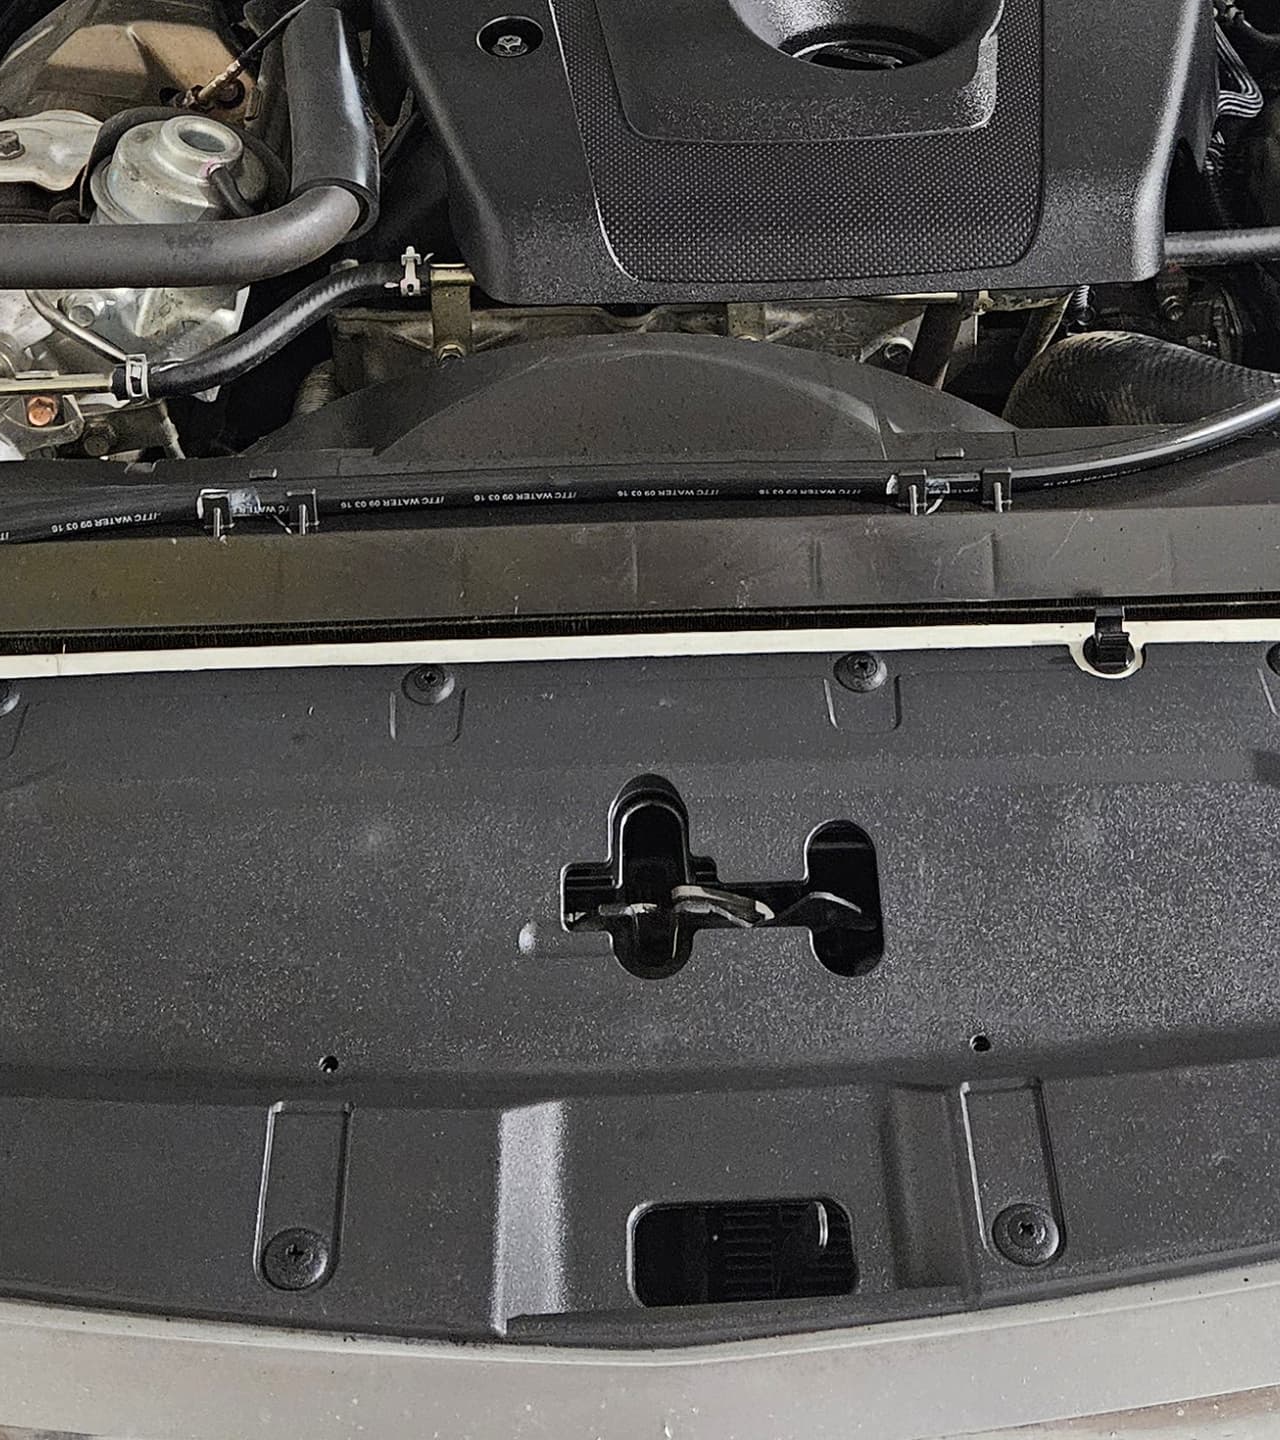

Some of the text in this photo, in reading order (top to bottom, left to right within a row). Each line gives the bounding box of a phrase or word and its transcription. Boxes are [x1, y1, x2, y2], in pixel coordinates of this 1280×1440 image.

[488, 493, 500, 501] 03
[502, 493, 514, 501] 09
[515, 491, 553, 501] WATER
[616, 490, 628, 498] 16
[631, 489, 642, 497] 03
[644, 489, 656, 497] 09
[658, 489, 695, 497] WATER
[382, 497, 421, 507] WATER
[473, 494, 485, 502] 16
[340, 501, 353, 509] 16
[355, 500, 367, 508] 03
[369, 499, 381, 508] 09
[80, 519, 93, 529] 09
[94, 515, 133, 528] WATER
[51, 524, 63, 533] 16
[65, 521, 78, 531] 03
